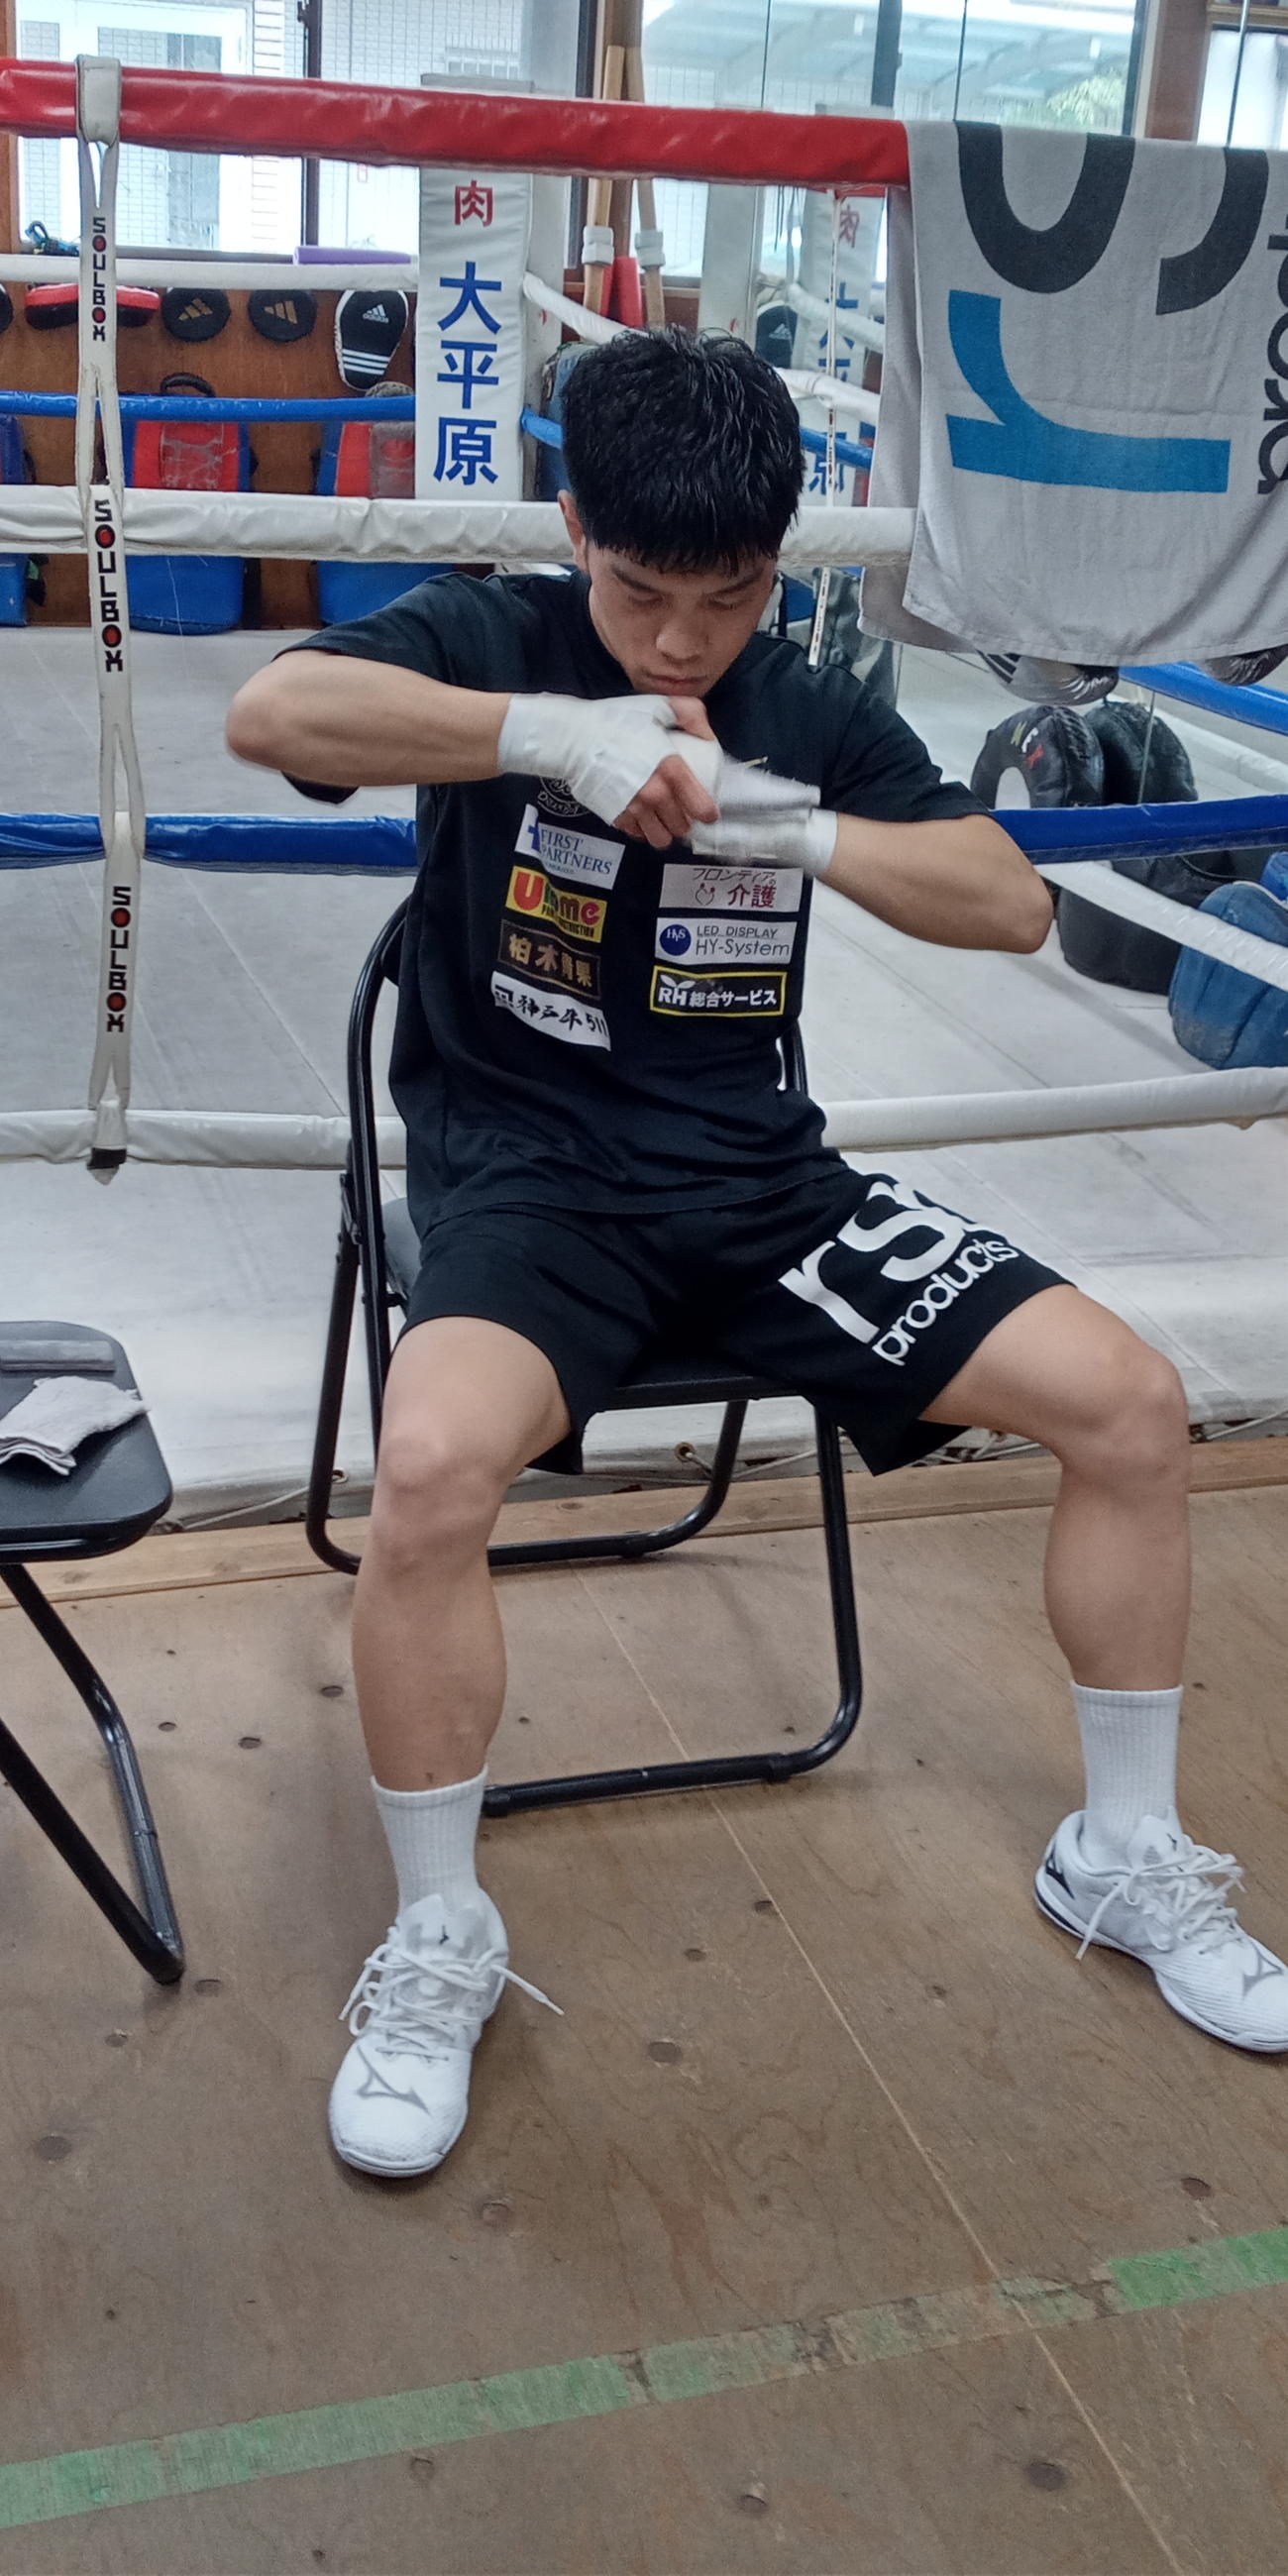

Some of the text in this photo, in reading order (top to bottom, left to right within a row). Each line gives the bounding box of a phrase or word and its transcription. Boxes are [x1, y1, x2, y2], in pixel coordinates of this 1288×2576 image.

[453, 179, 494, 228] 肉
[93, 216, 107, 342] SOULBOX
[433, 261, 503, 485] 大平原
[94, 499, 124, 673] SOULBOX
[541, 828, 584, 852] FIRST
[728, 883, 777, 909] 介護
[696, 938, 791, 957] HY-System
[697, 925, 779, 939] LED DISPLAY
[106, 886, 131, 1032] SOULBOX
[658, 986, 777, 1009] RH 総合サービス
[872, 1237, 1020, 1366] products
